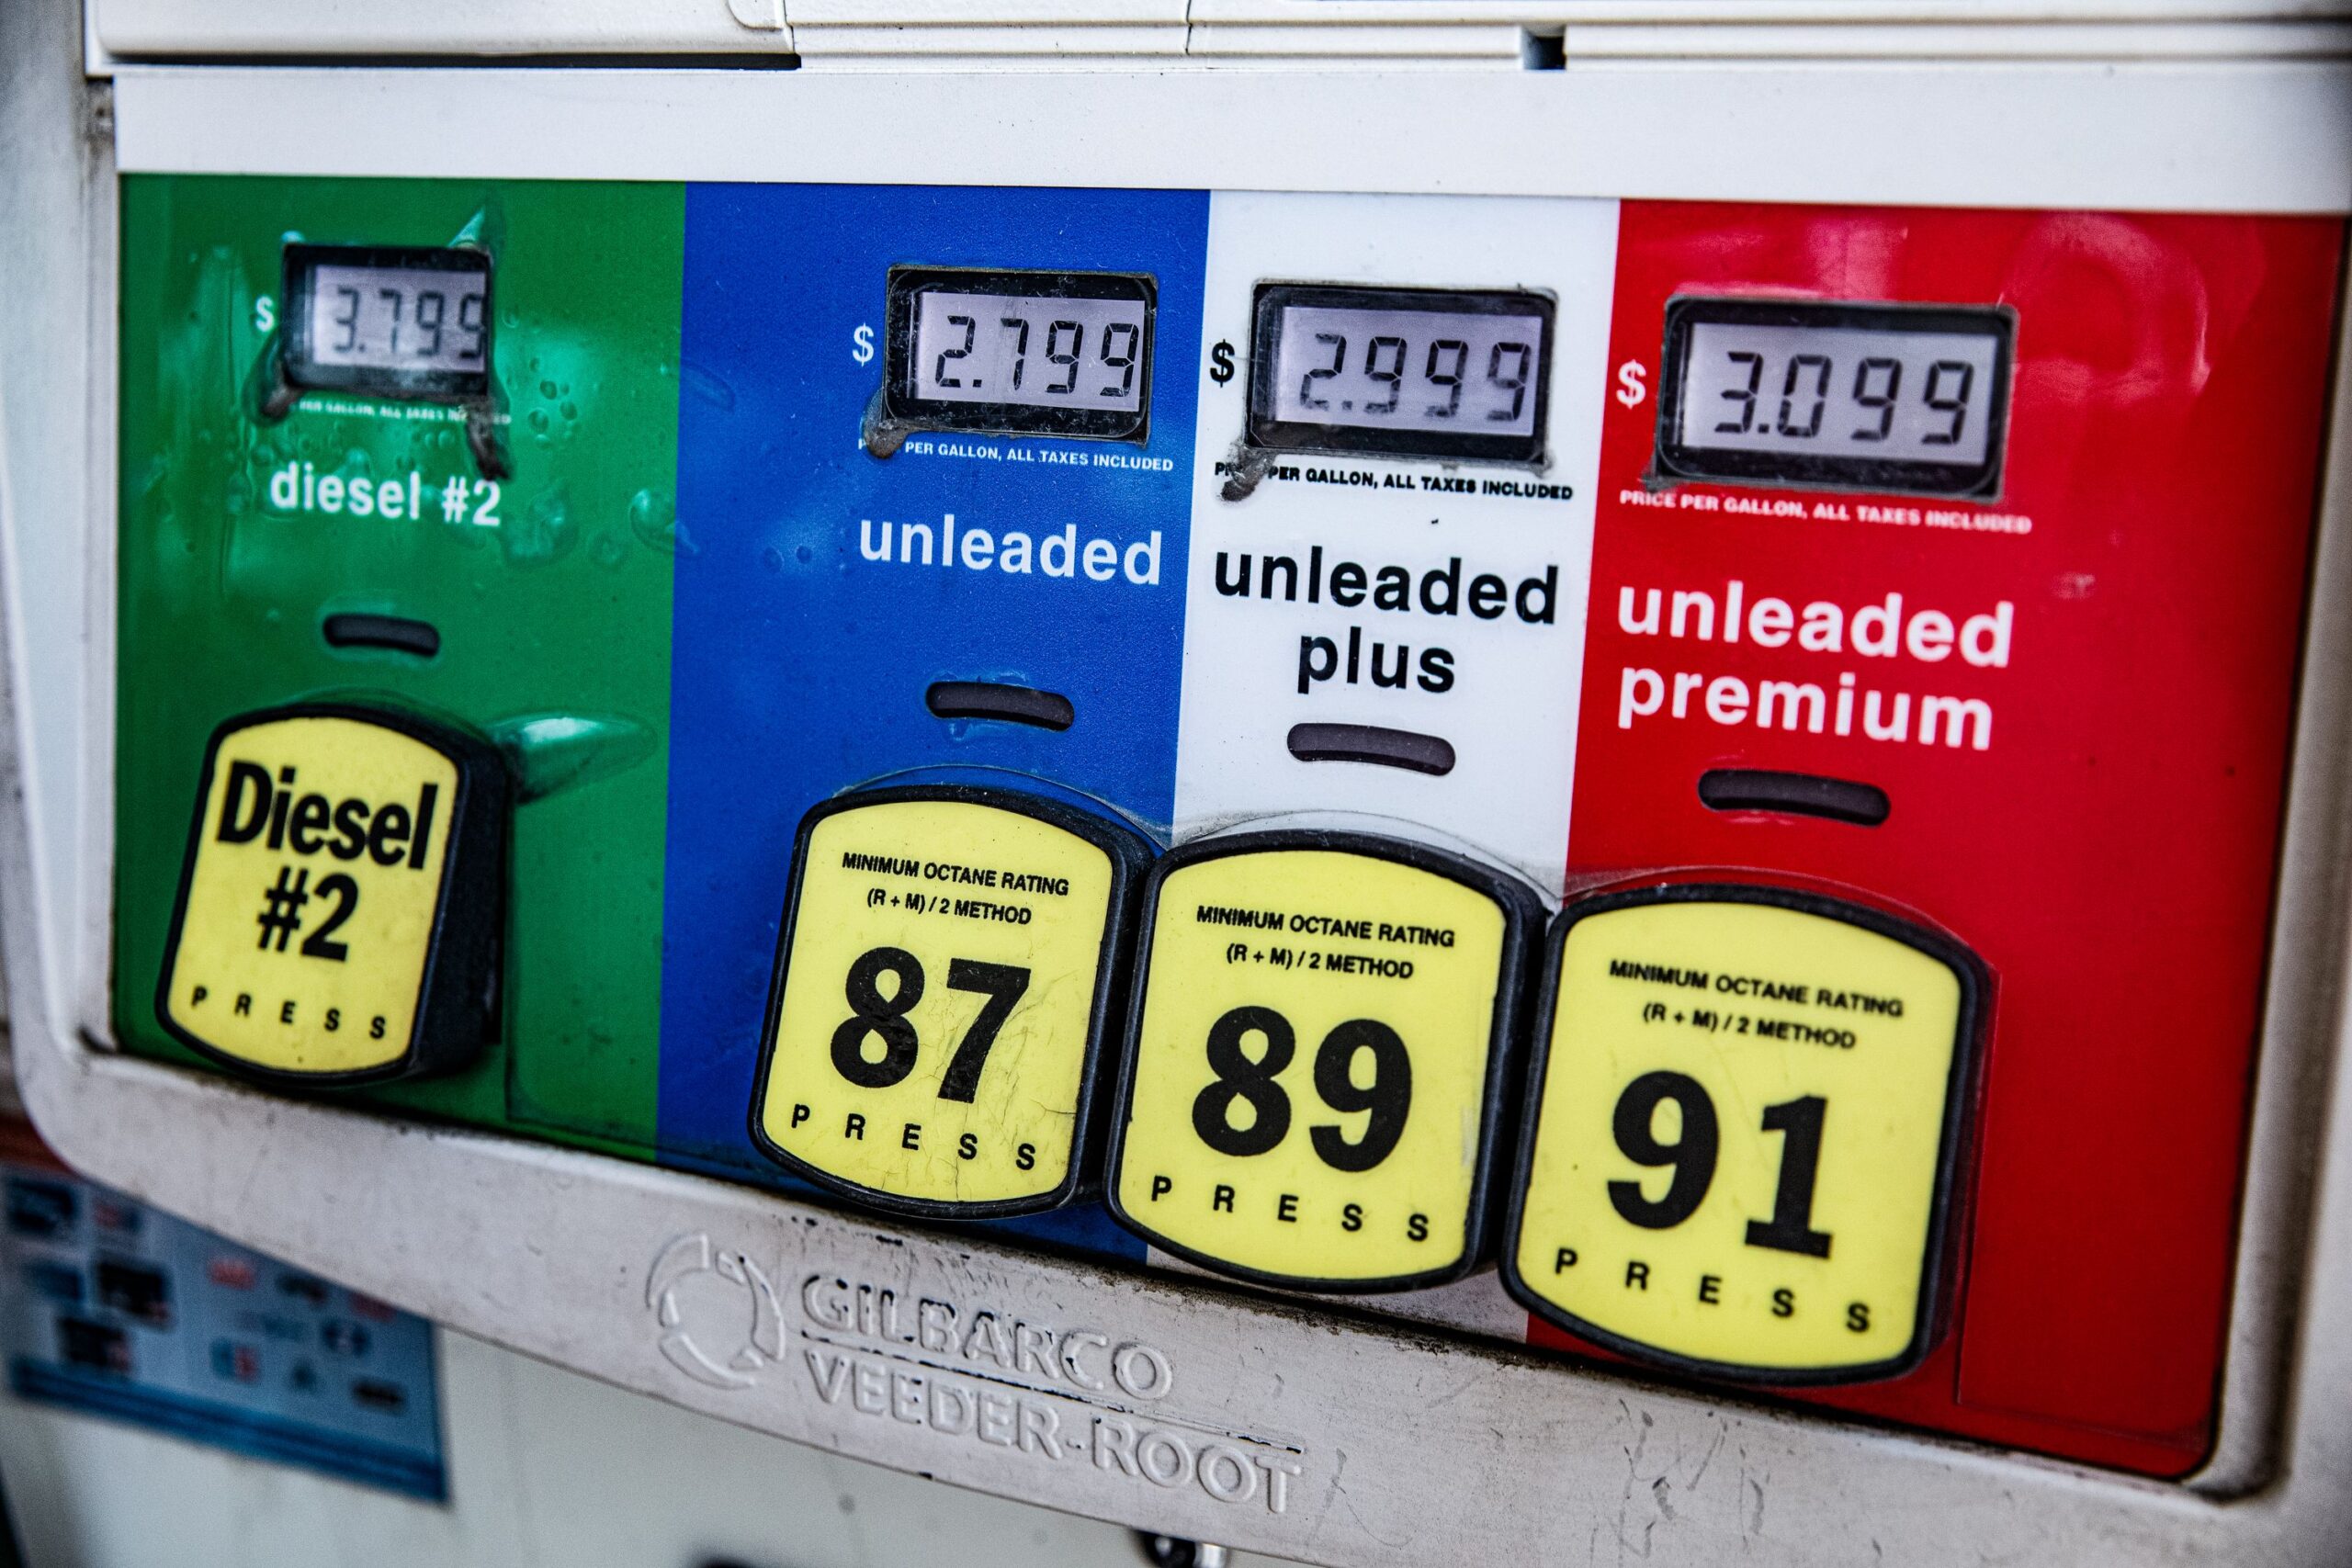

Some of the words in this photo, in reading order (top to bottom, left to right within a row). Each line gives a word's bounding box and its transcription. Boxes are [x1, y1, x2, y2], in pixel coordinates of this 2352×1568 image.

[334, 287, 487, 358] 3.799
[852, 322, 874, 366] $
[935, 315, 1139, 398] 2.799
[1209, 339, 1235, 388] $
[1300, 333, 1532, 423] 2.999
[1616, 359, 1646, 409] $
[1713, 351, 1975, 446] 3.099
[905, 441, 933, 455] PER
[938, 444, 1001, 462] GALLON,
[1007, 447, 1035, 462] ALL
[1039, 450, 1088, 466] TAXES
[1093, 454, 1173, 471] INCLUDED
[1268, 466, 1300, 481] PER
[1306, 468, 1378, 490] GALLON,
[1384, 474, 1416, 490] ALL
[1421, 476, 1476, 493] TAXES
[1483, 480, 1573, 501] INCLUDED
[270, 462, 420, 520] diesel
[440, 476, 501, 526] #2
[1620, 490, 1677, 508] PRICE
[1680, 493, 1719, 511] PER
[1724, 496, 1808, 520] GALLON,
[1813, 502, 1850, 522] ALL
[1857, 504, 1921, 526] TAXES
[1925, 510, 2032, 535] INCLUDED
[860, 513, 1162, 586] unleaded
[1215, 546, 1559, 625] unleaded
[1297, 626, 1455, 694] plus
[1618, 580, 2014, 668] unleaded
[1618, 666, 1993, 750] premium
[216, 760, 438, 870] Diesel
[842, 852, 920, 877] MINIMUM
[923, 863, 997, 887] OCTANE
[1001, 872, 1069, 896] RATING
[257, 865, 359, 963] #2
[954, 899, 1032, 925] METHOD
[1196, 906, 1284, 931] MINIMUM
[1289, 915, 1373, 940] OCTANE
[1377, 923, 1455, 948] RATING
[1326, 953, 1414, 979] METHOD
[1609, 959, 1709, 989] MINIMUM
[1715, 975, 1808, 1005] OCTANE
[1816, 988, 1904, 1018] RATING
[190, 986, 387, 1040] PRESS
[830, 946, 1032, 1104] 87
[1757, 1019, 1856, 1049] METHOD
[1192, 1005, 1412, 1173] 89
[791, 1103, 1035, 1171] PRESS
[1607, 1069, 1833, 1260] 91
[1151, 1175, 1429, 1242] PRESS
[1554, 1247, 1871, 1335] PRESS
[801, 1273, 1173, 1401] GILBARCO
[802, 1348, 1302, 1514] VEEDER-ROOT
